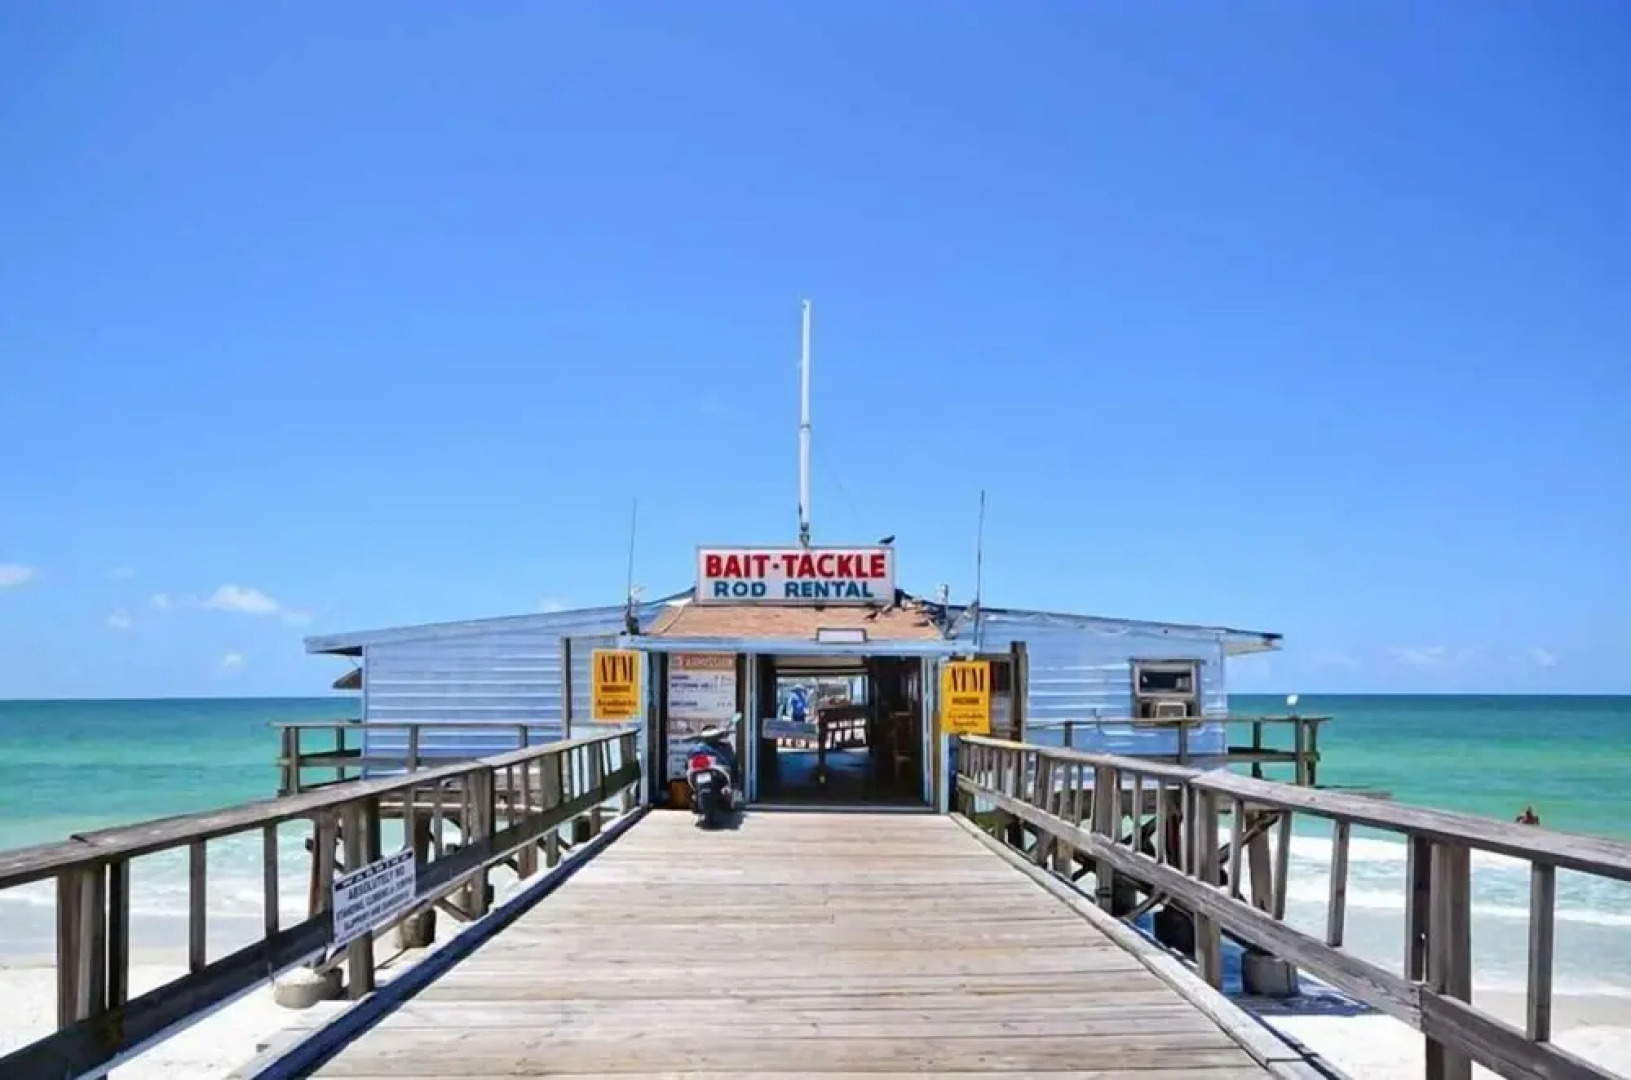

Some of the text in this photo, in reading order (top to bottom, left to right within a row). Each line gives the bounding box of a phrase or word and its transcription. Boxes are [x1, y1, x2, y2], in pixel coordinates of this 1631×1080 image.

[714, 581, 875, 598] ROD RENTAL
[600, 655, 635, 683] ATM
[951, 666, 985, 693] ATM
